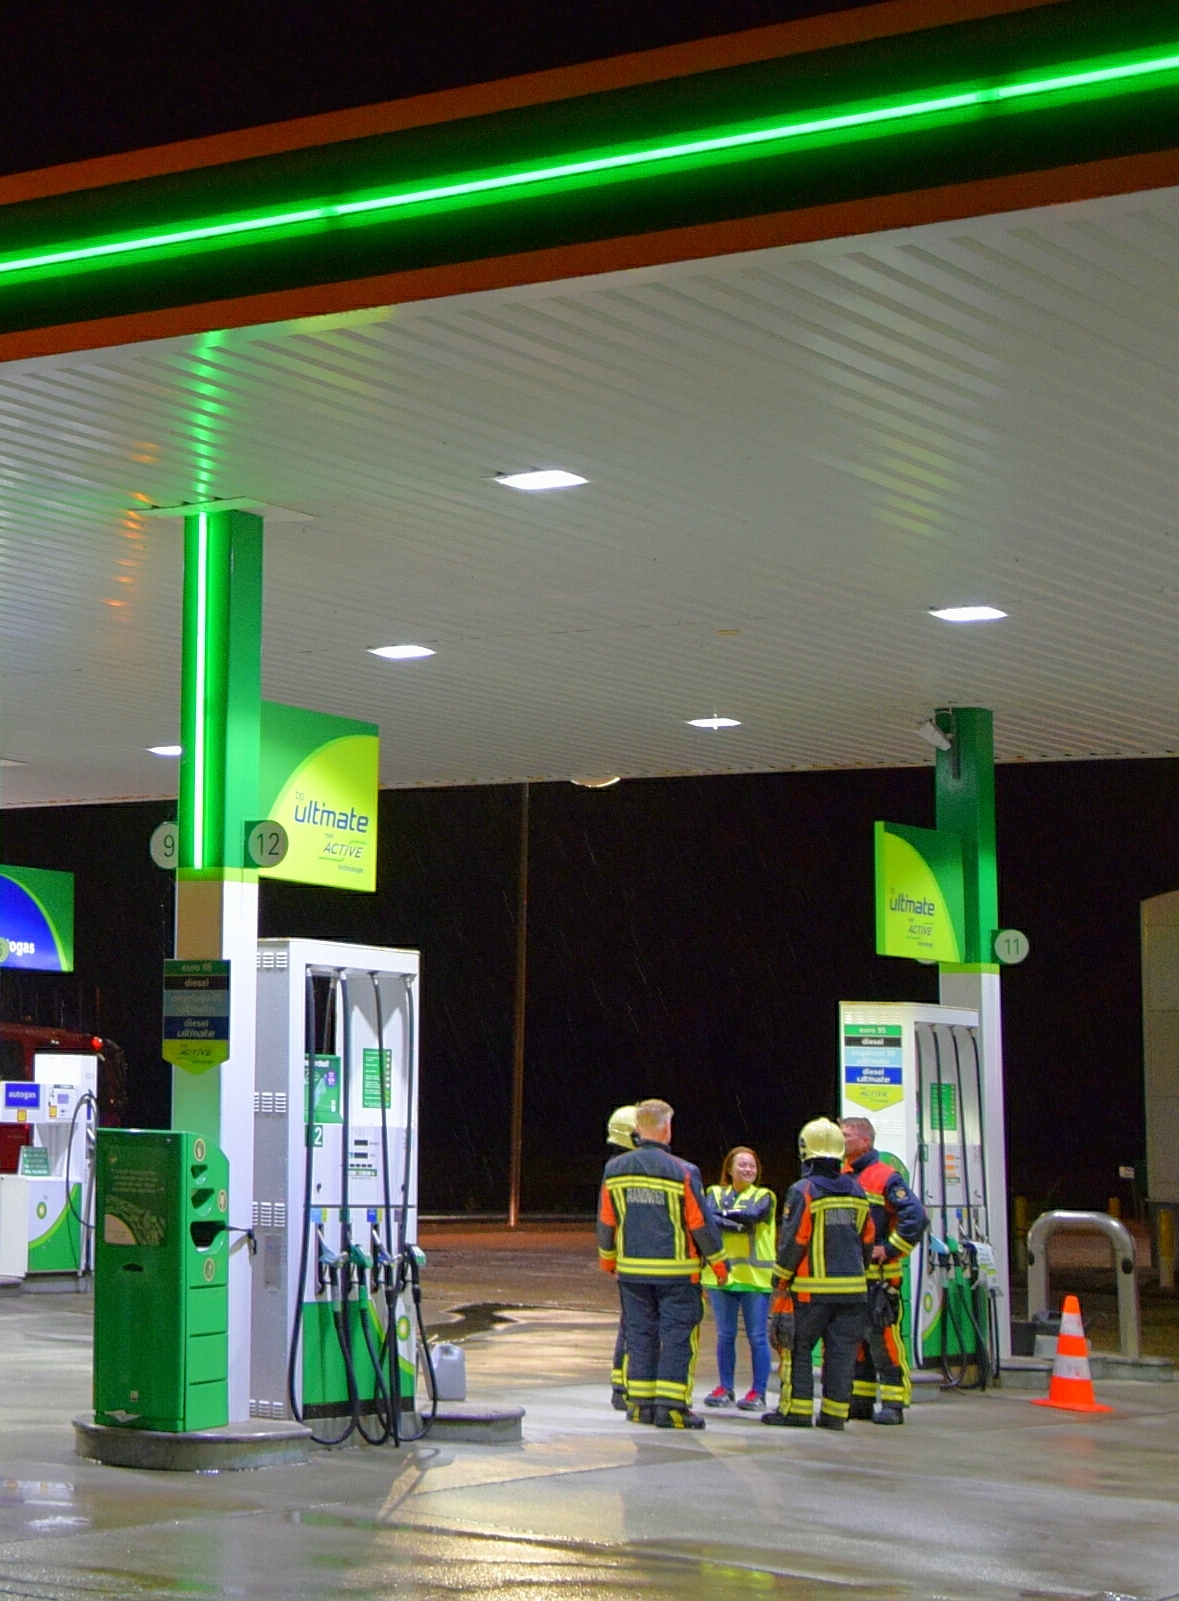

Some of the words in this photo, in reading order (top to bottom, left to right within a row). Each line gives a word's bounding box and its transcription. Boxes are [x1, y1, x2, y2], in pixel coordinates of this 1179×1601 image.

[295, 789, 305, 802] bp
[293, 800, 370, 834] ultimate
[163, 834, 175, 858] 9
[256, 832, 280, 856] 12
[323, 842, 364, 859] ACTIVE
[889, 893, 935, 917] ultimate
[1004, 938, 1020, 955] 11
[184, 978, 209, 988] diesel
[184, 1018, 209, 1028] diesel
[861, 1038, 885, 1046] diesel
[862, 1068, 885, 1076] diesel
[8, 1091, 37, 1100] autogas
